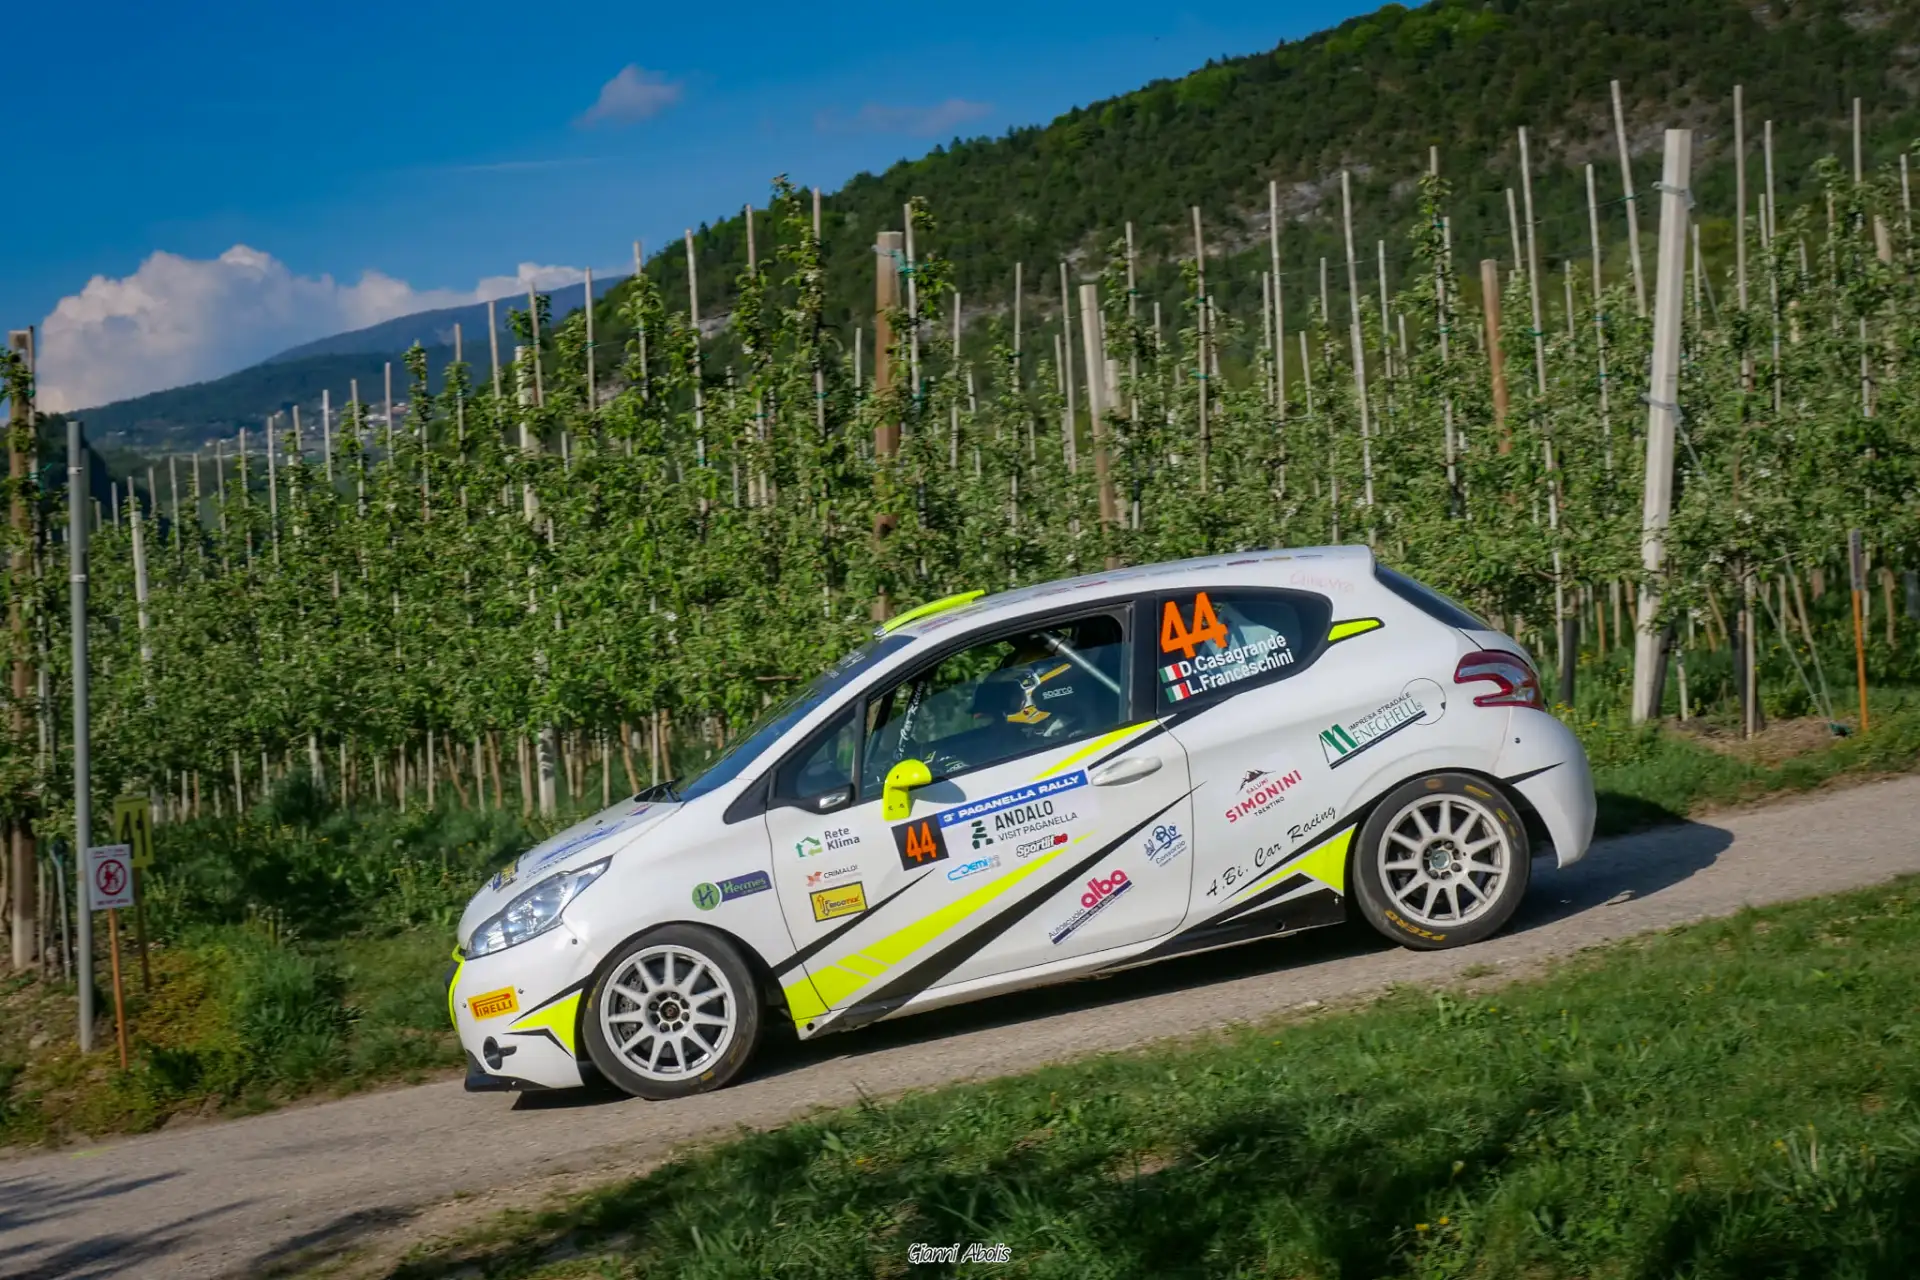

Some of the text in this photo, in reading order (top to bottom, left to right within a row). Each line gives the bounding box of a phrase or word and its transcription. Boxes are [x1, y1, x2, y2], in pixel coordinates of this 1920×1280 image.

[1160, 592, 1229, 659] 44
[1178, 634, 1287, 678] D.Casagrande
[1185, 648, 1295, 695] L.Franceschini
[1348, 712, 1377, 731] IMPRESA
[1377, 691, 1411, 714] STRADALE
[958, 789, 1037, 818] PAGANELLA
[1039, 775, 1080, 794] RALLY
[1225, 769, 1303, 823] SIMONINI
[1246, 778, 1269, 794] SALUMI
[995, 800, 1054, 831] ANDALO
[1254, 796, 1285, 817] TRENTINO
[824, 827, 850, 840] Rete
[906, 821, 937, 862] 44
[998, 812, 1078, 841] VISIT PAGANELLA
[1255, 843, 1281, 868] Car
[1287, 806, 1336, 842] Racing
[827, 835, 861, 851] Klima
[1155, 840, 1186, 864] Consorzio
[723, 877, 767, 893] Hermes
[1081, 870, 1128, 908] alba
[1048, 908, 1086, 938] Autoscuola
[472, 993, 513, 1018] PIRELLI
